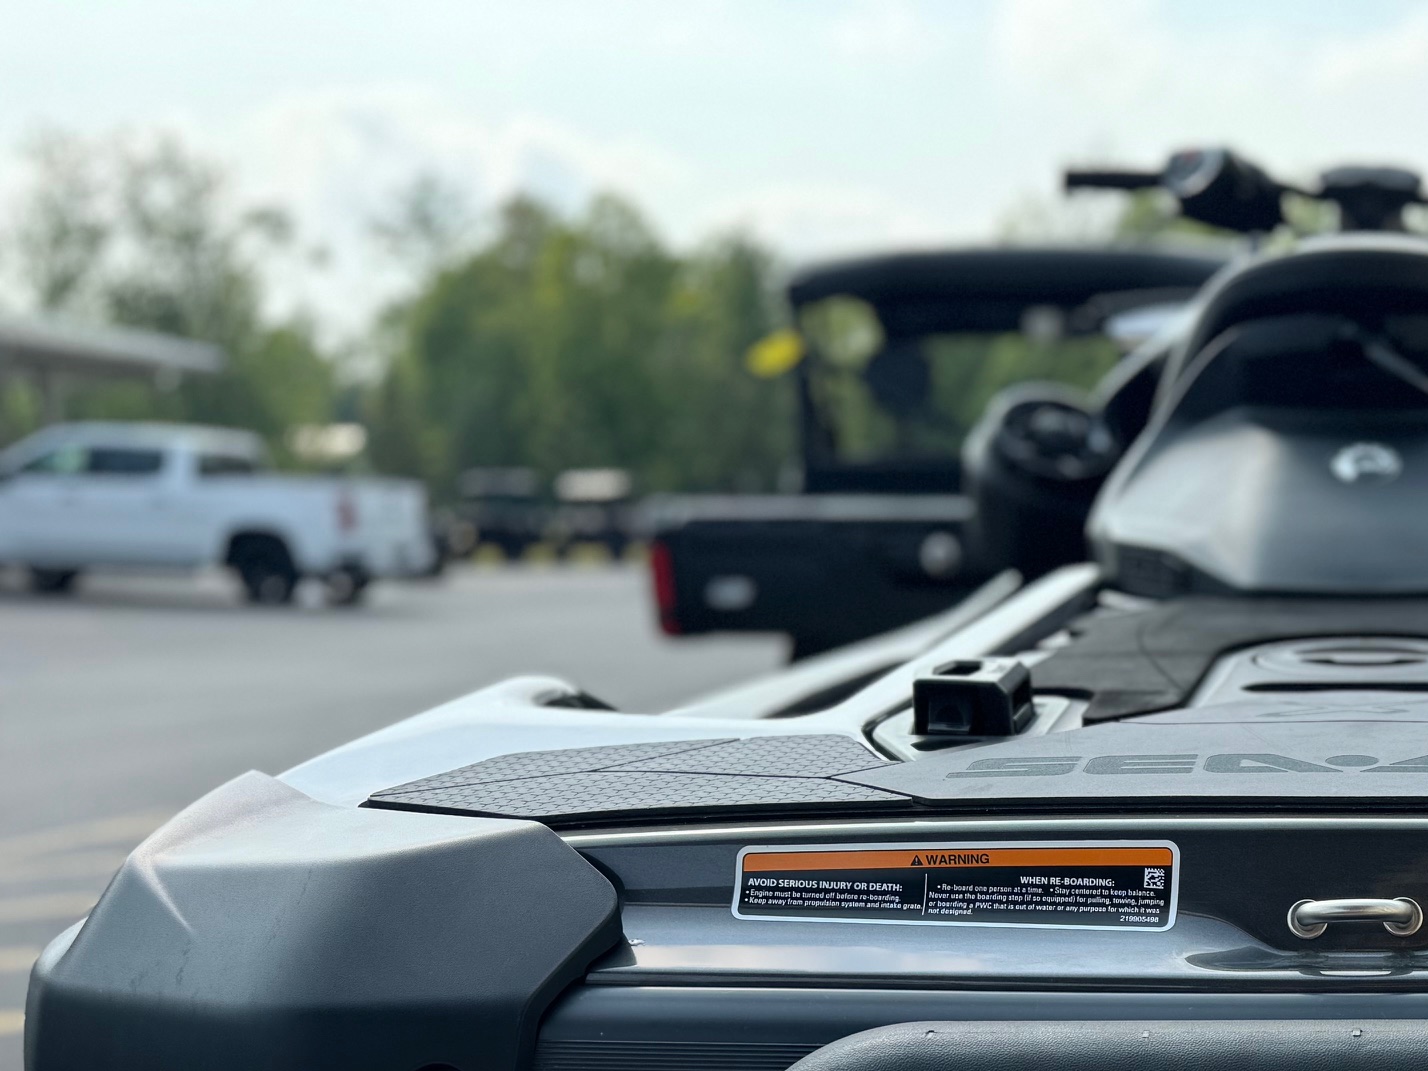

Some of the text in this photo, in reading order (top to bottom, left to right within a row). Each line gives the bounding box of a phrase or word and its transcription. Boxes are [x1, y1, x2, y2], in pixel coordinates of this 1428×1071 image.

[925, 853, 990, 865] WARNING
[748, 878, 903, 892] AVOID SERIOUS INJURY OR DEATH:
[1020, 876, 1115, 887] WHEN RE-BOARDING:
[942, 883, 973, 892] Re-board
[1054, 886, 1070, 895] Stay
[750, 889, 773, 898] Engine
